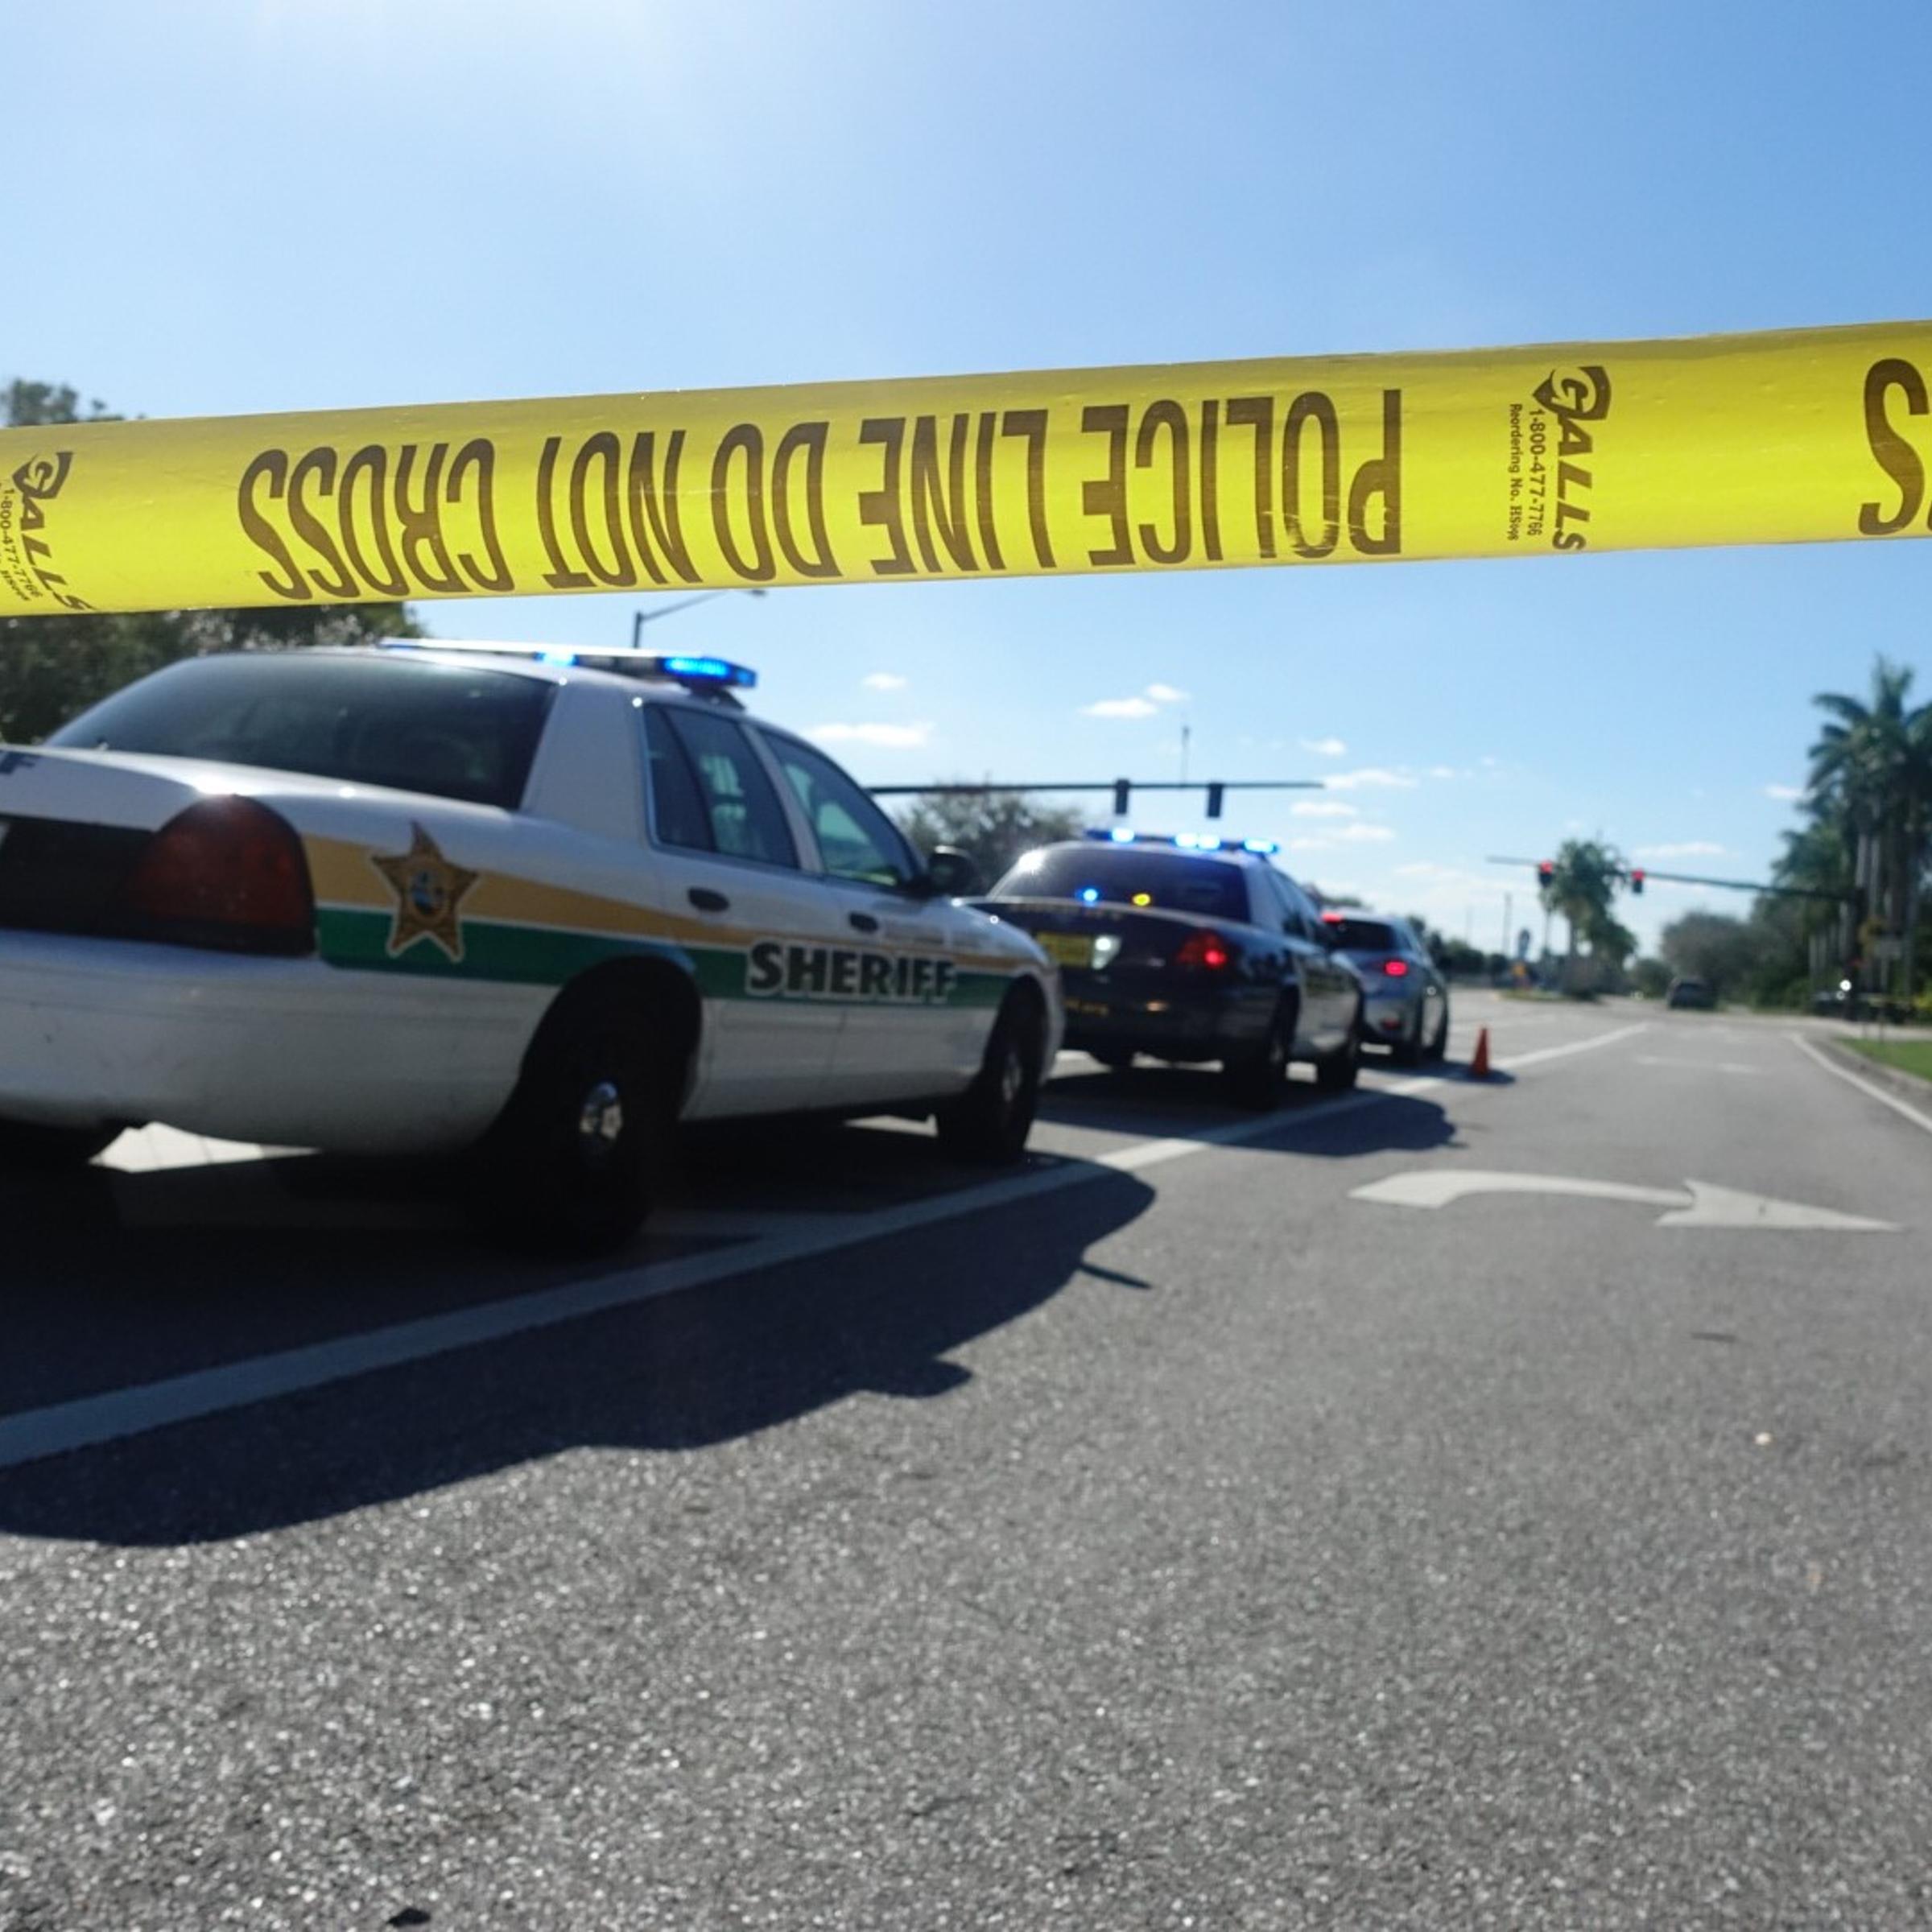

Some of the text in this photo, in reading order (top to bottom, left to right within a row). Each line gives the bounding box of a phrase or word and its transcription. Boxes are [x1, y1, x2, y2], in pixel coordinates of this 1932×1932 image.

[1508, 403, 1523, 473] Reordering
[1529, 409, 1546, 536] 1-800-477-7766
[1532, 365, 1612, 551] GALLS
[238, 390, 1401, 600] POLICE LINE DO NOT CROSS
[1509, 477, 1522, 502] No.
[747, 939, 957, 1001] SHERIFF
